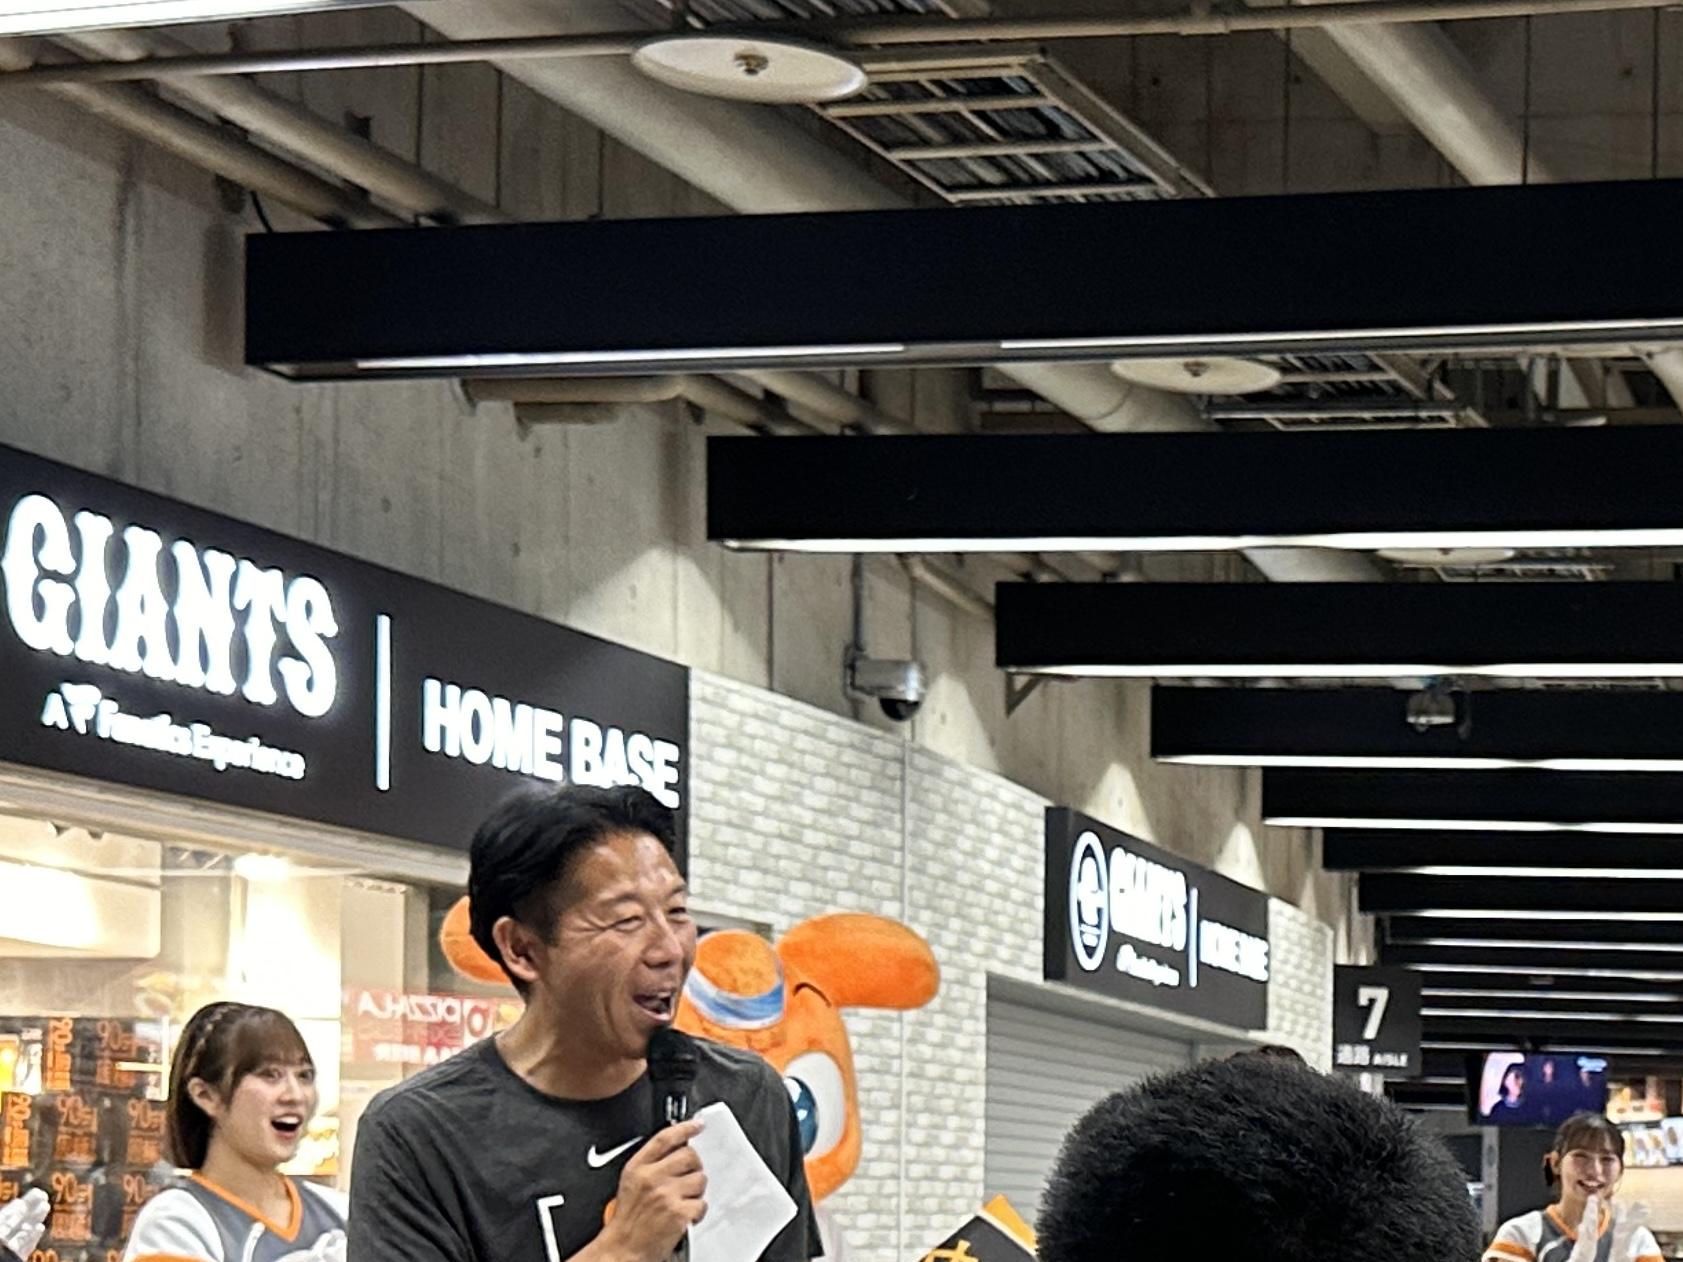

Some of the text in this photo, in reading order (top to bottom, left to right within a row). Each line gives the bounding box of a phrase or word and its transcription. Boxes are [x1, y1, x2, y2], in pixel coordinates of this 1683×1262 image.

[3, 494, 338, 717] GIANTS
[423, 677, 680, 809] HOME BASE
[1357, 985, 1390, 1040] 7
